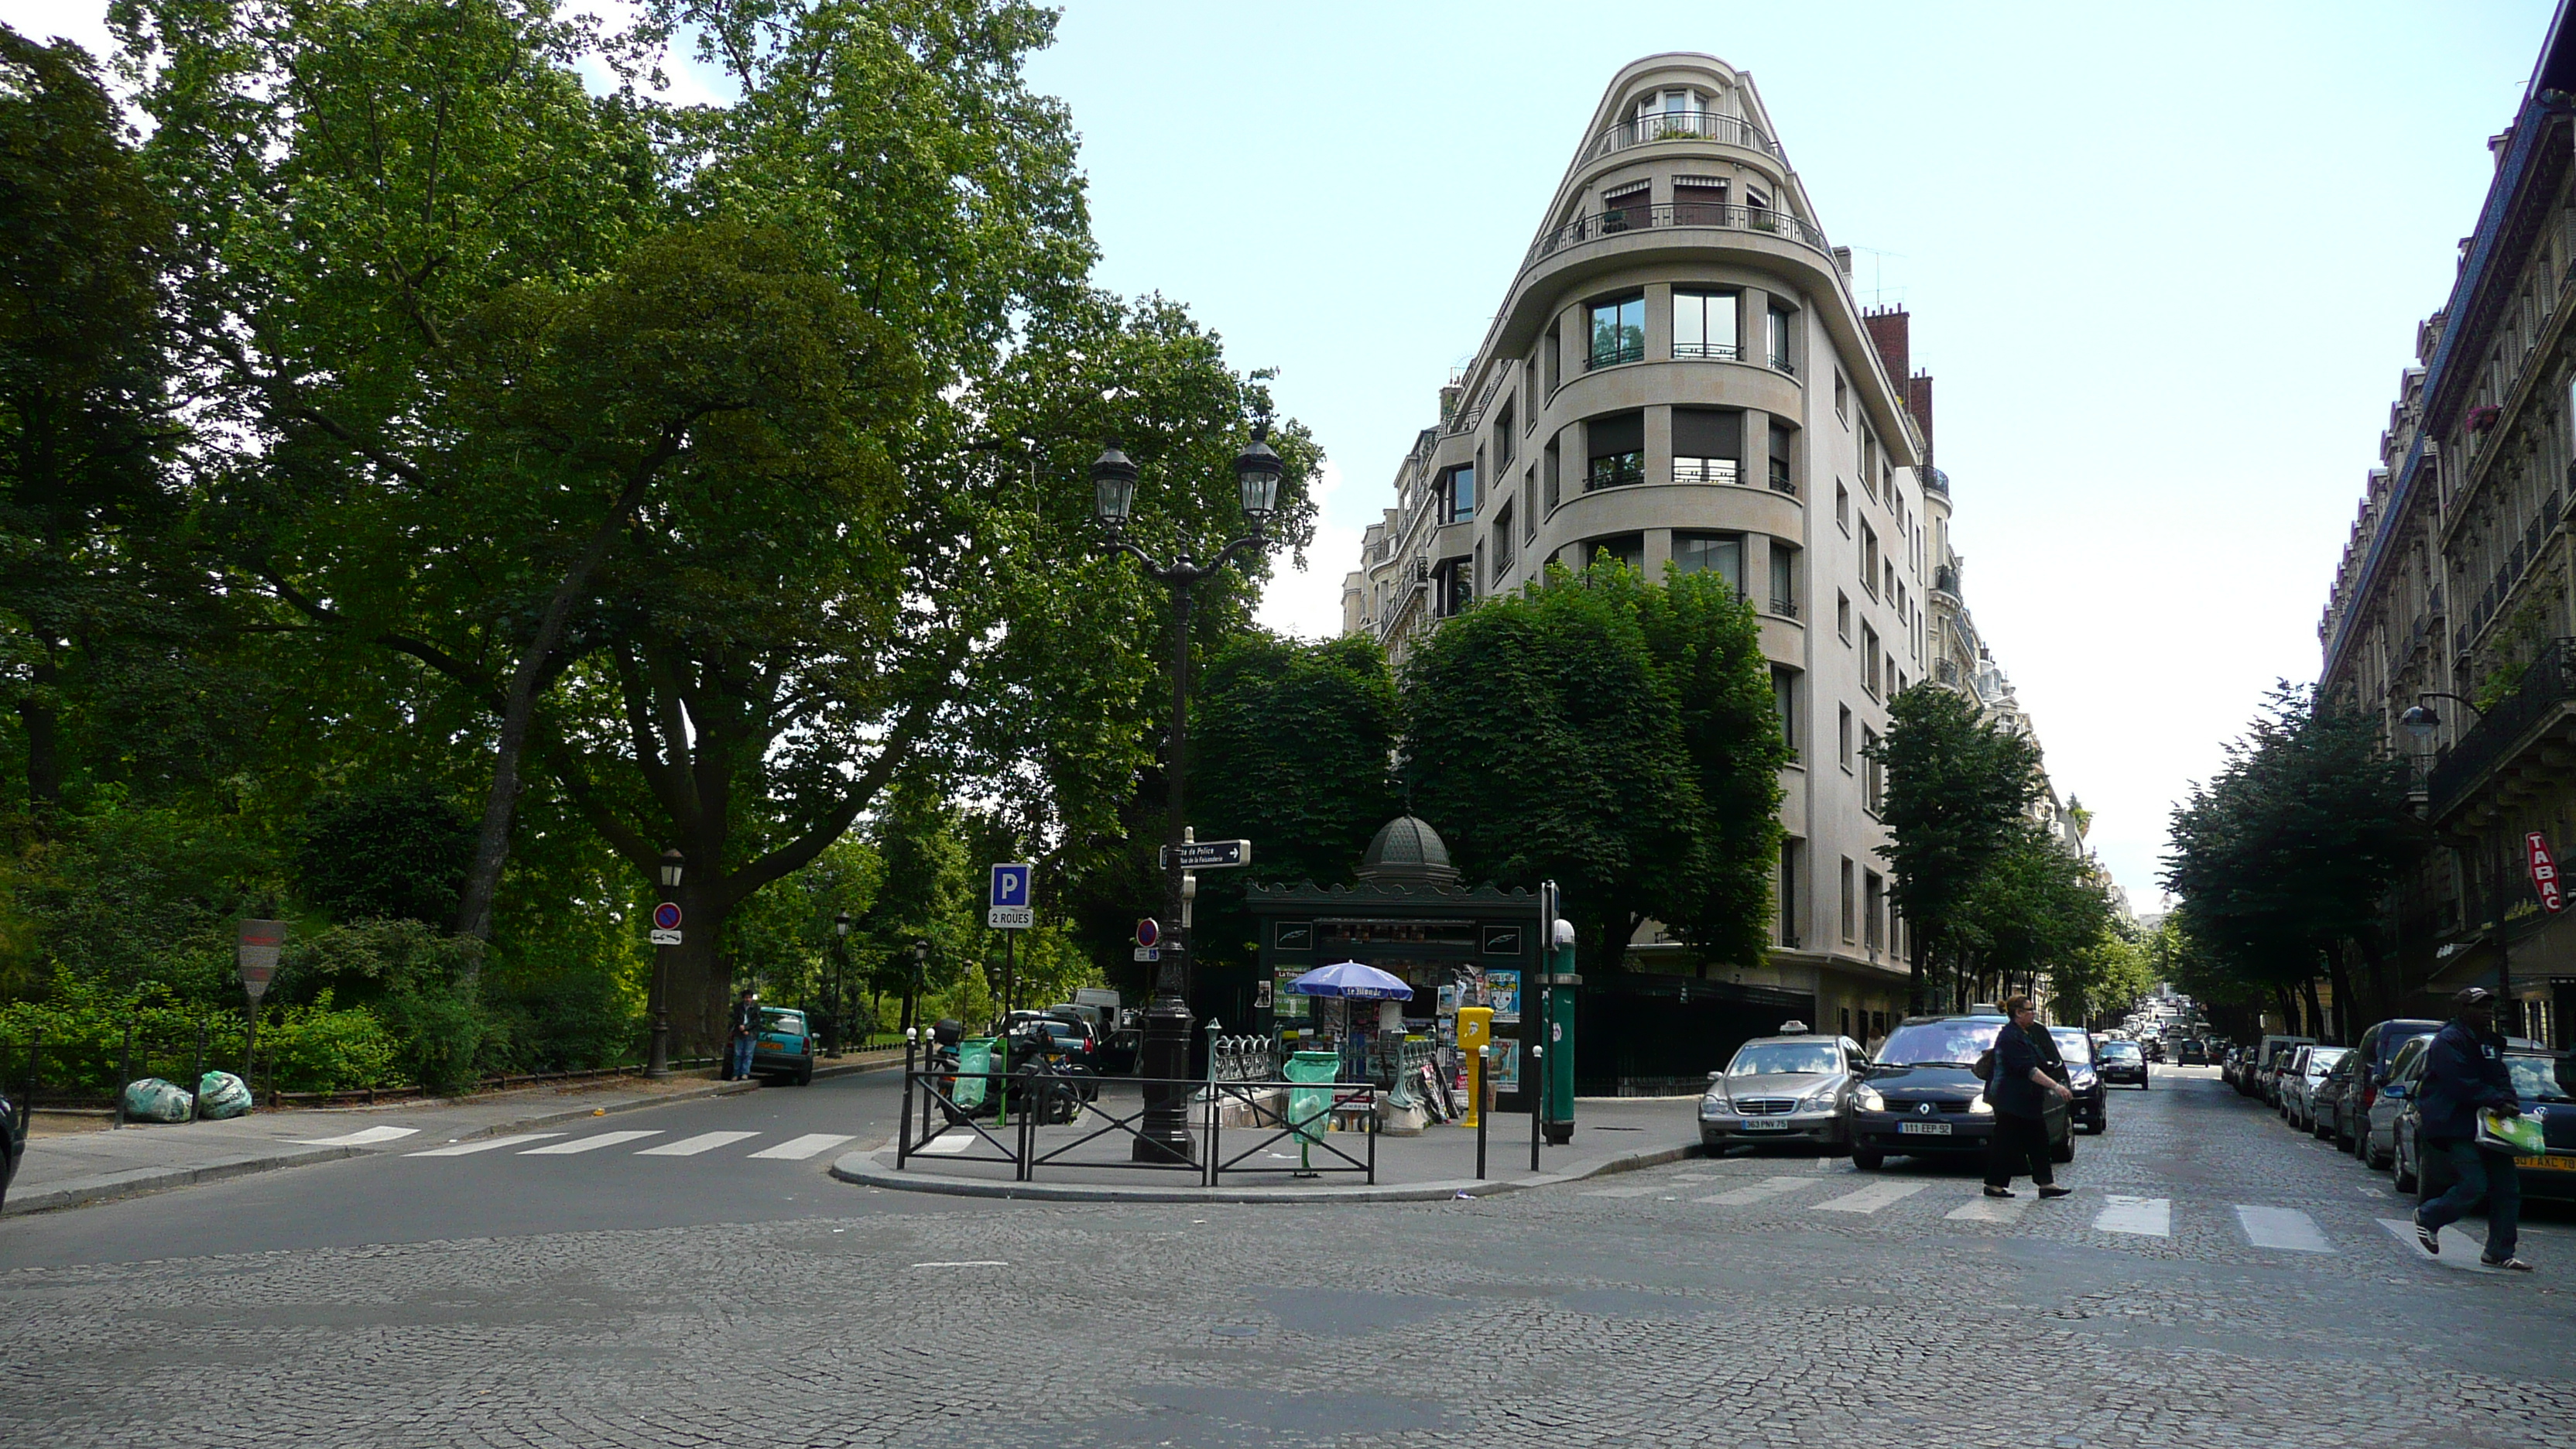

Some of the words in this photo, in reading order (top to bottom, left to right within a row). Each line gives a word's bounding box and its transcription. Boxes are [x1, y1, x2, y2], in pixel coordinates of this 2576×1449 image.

[1197, 847, 1214, 855] Police
[2530, 836, 2560, 909] TABAC
[1002, 873, 1018, 899] P
[992, 913, 998, 923] 2
[1001, 913, 1029, 923] ROUES
[1356, 988, 1382, 996] Monde
[1905, 1124, 1918, 1132] 111
[1922, 1124, 1937, 1133] EEP
[1939, 1125, 1950, 1134] 92
